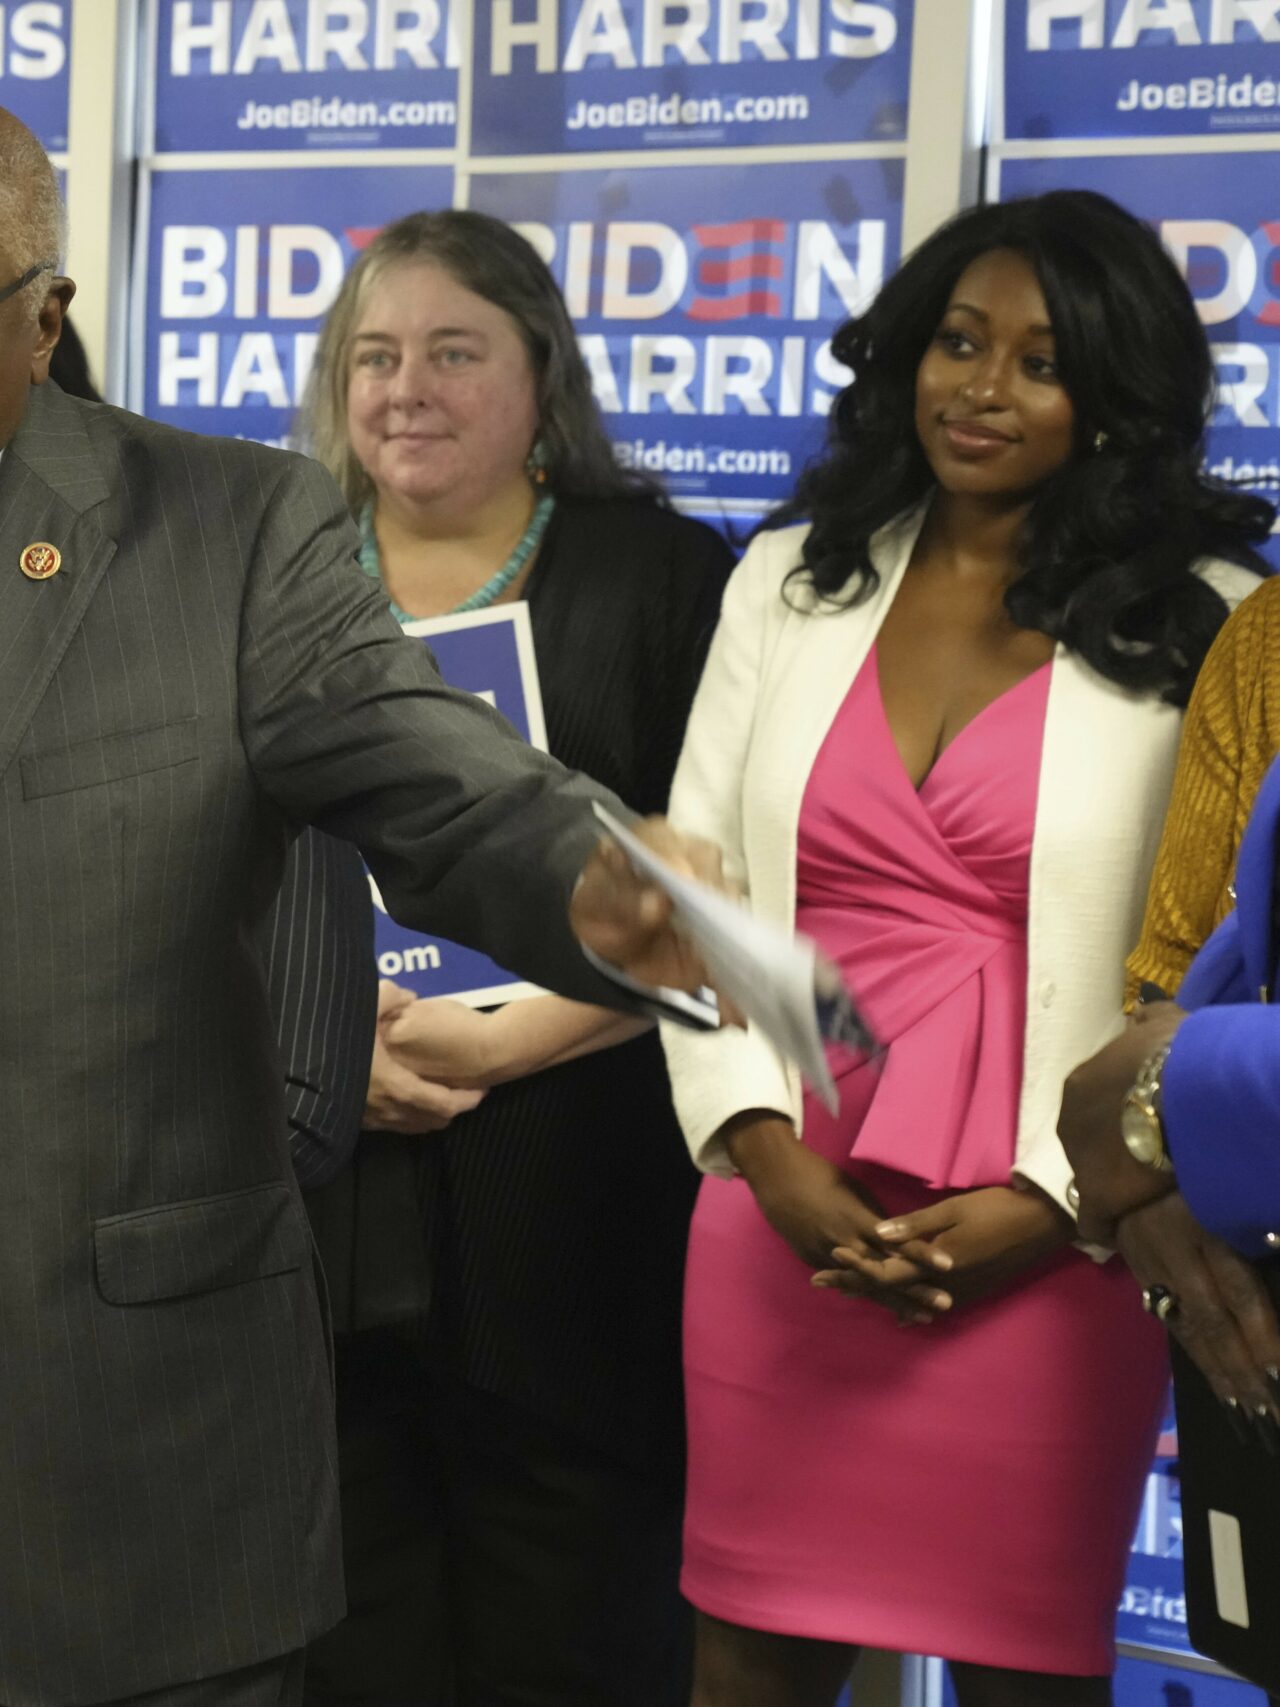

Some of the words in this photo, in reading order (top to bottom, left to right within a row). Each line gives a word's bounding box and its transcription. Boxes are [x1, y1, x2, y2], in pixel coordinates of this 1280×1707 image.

[491, 0, 898, 75] HARRIS
[1116, 73, 1280, 111] JoeBide
[236, 97, 457, 130] JoeBiden.com
[566, 94, 810, 130] JoeBiden.com
